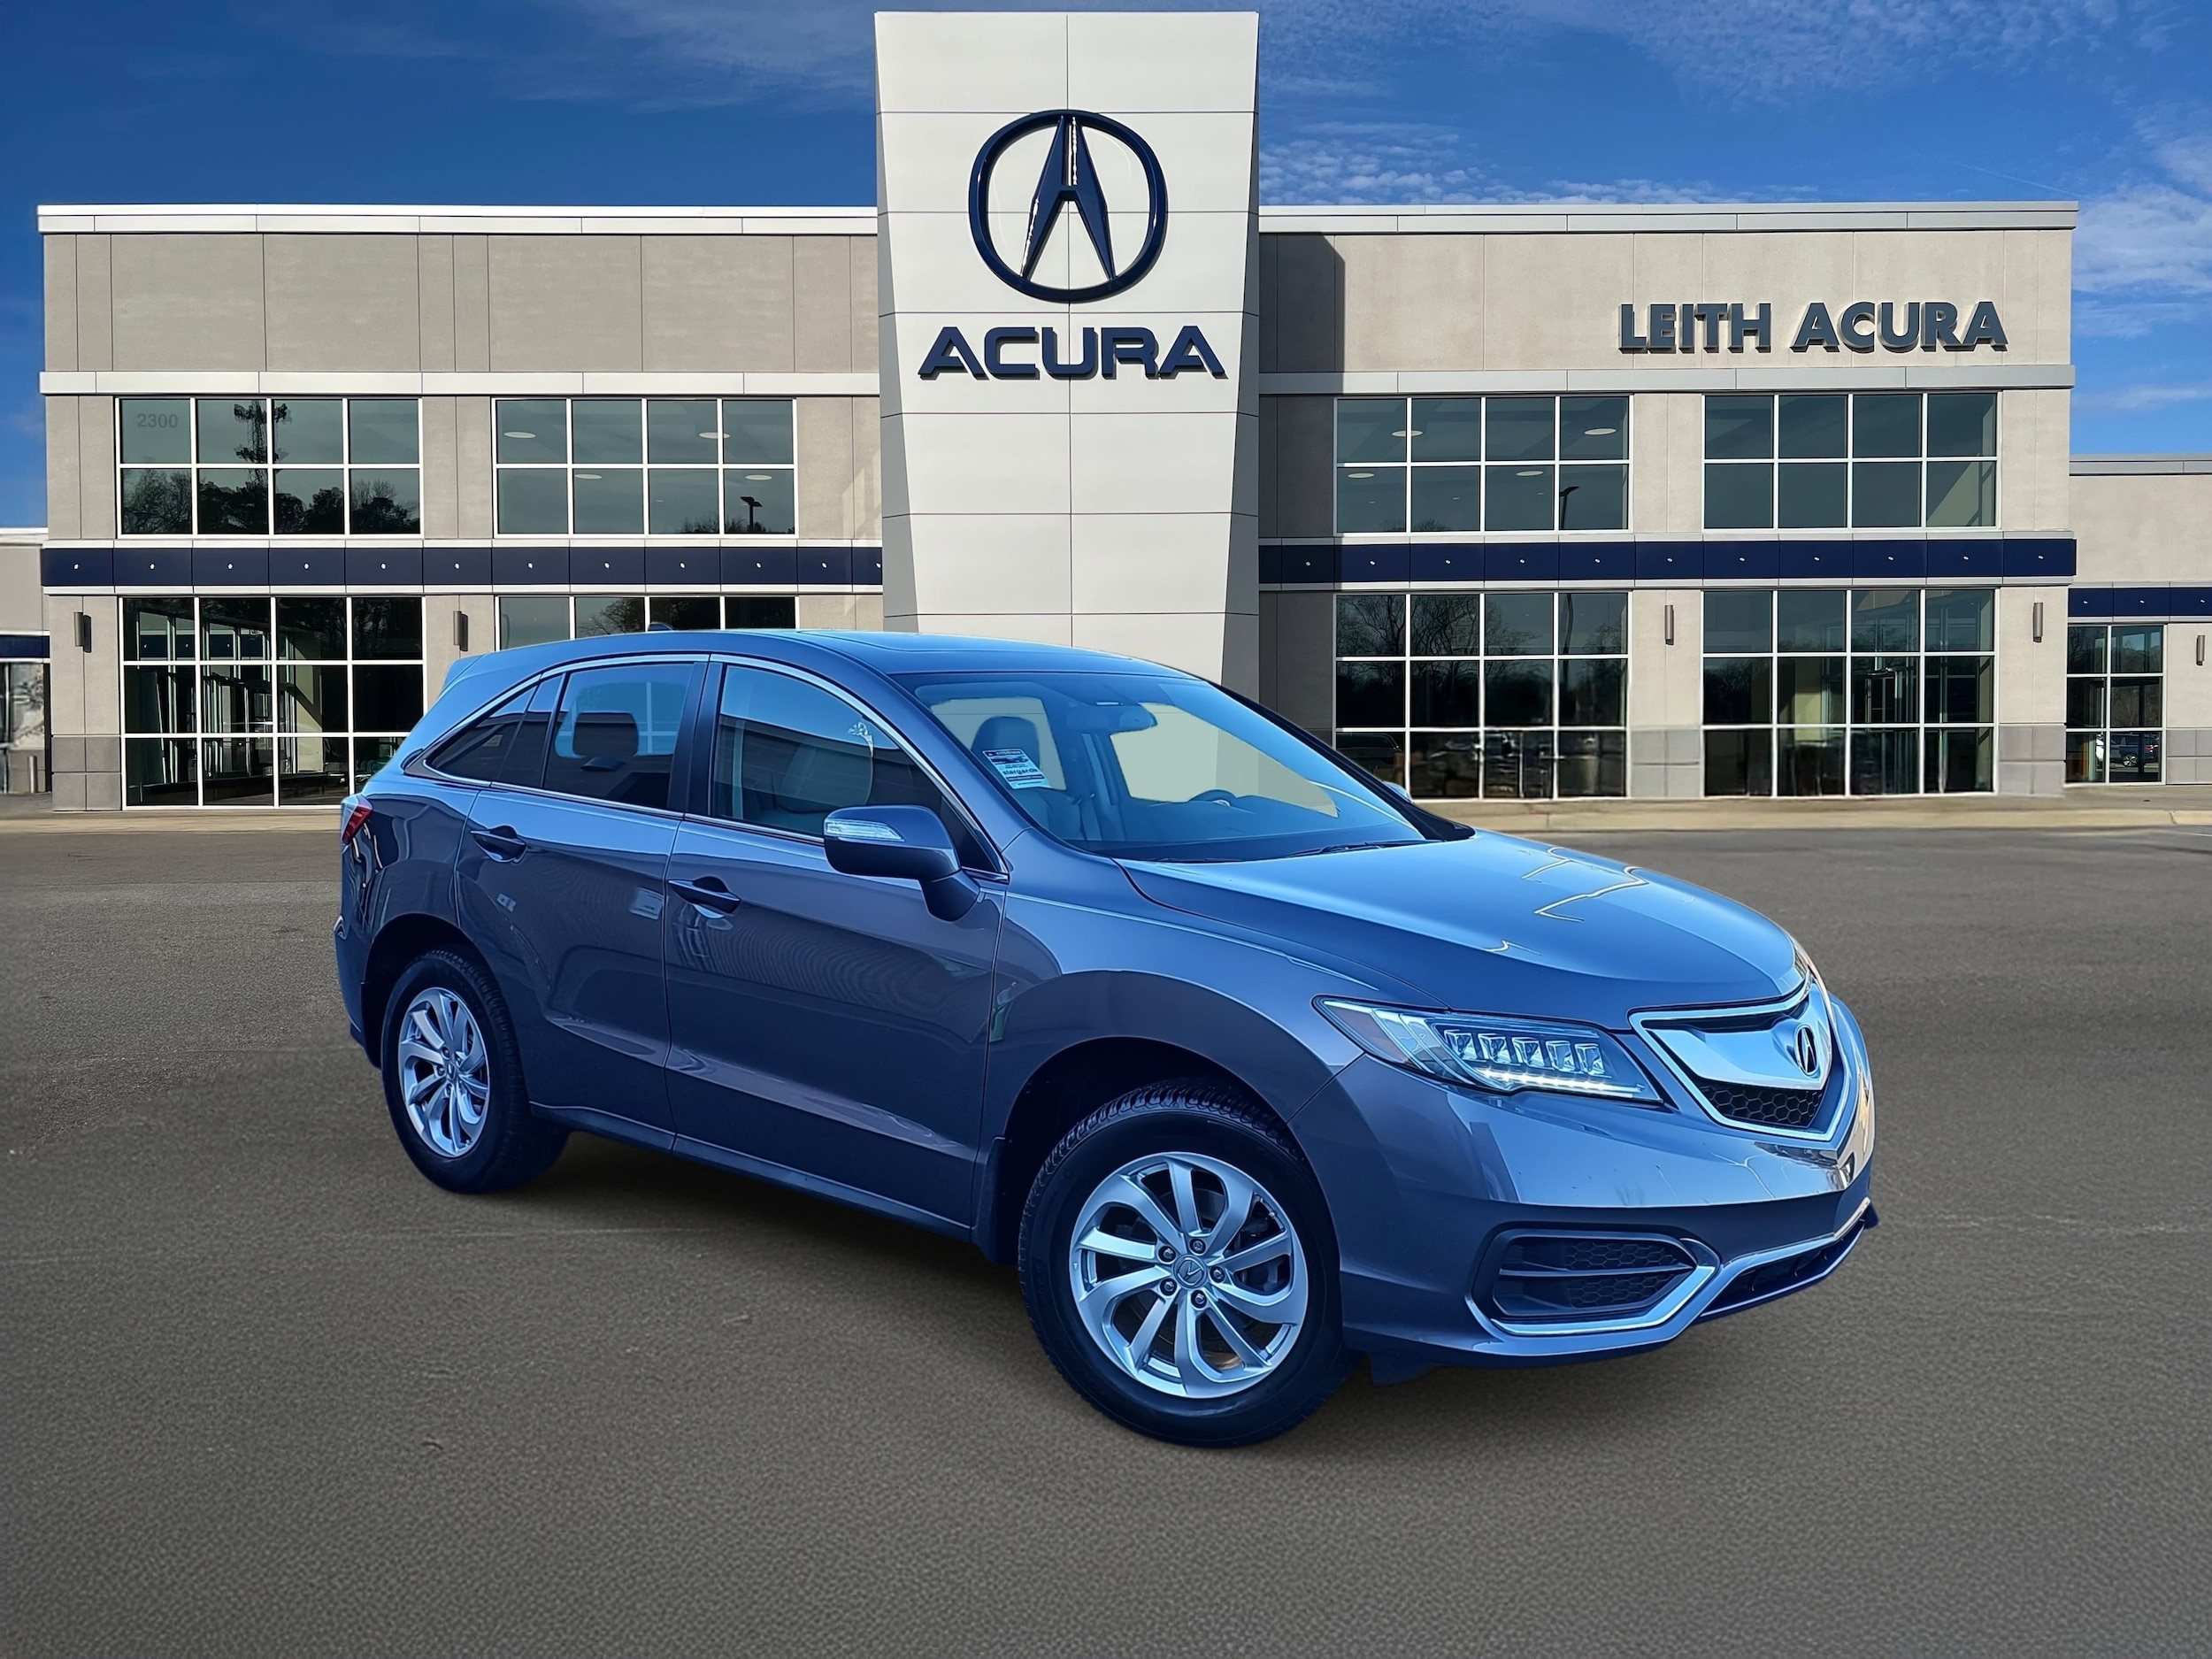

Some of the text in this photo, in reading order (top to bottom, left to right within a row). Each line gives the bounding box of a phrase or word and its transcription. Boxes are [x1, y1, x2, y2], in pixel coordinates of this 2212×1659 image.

[918, 325, 1229, 380] ACURA
[1618, 300, 2008, 354] LEITH ACURA
[136, 412, 179, 428] 2300
